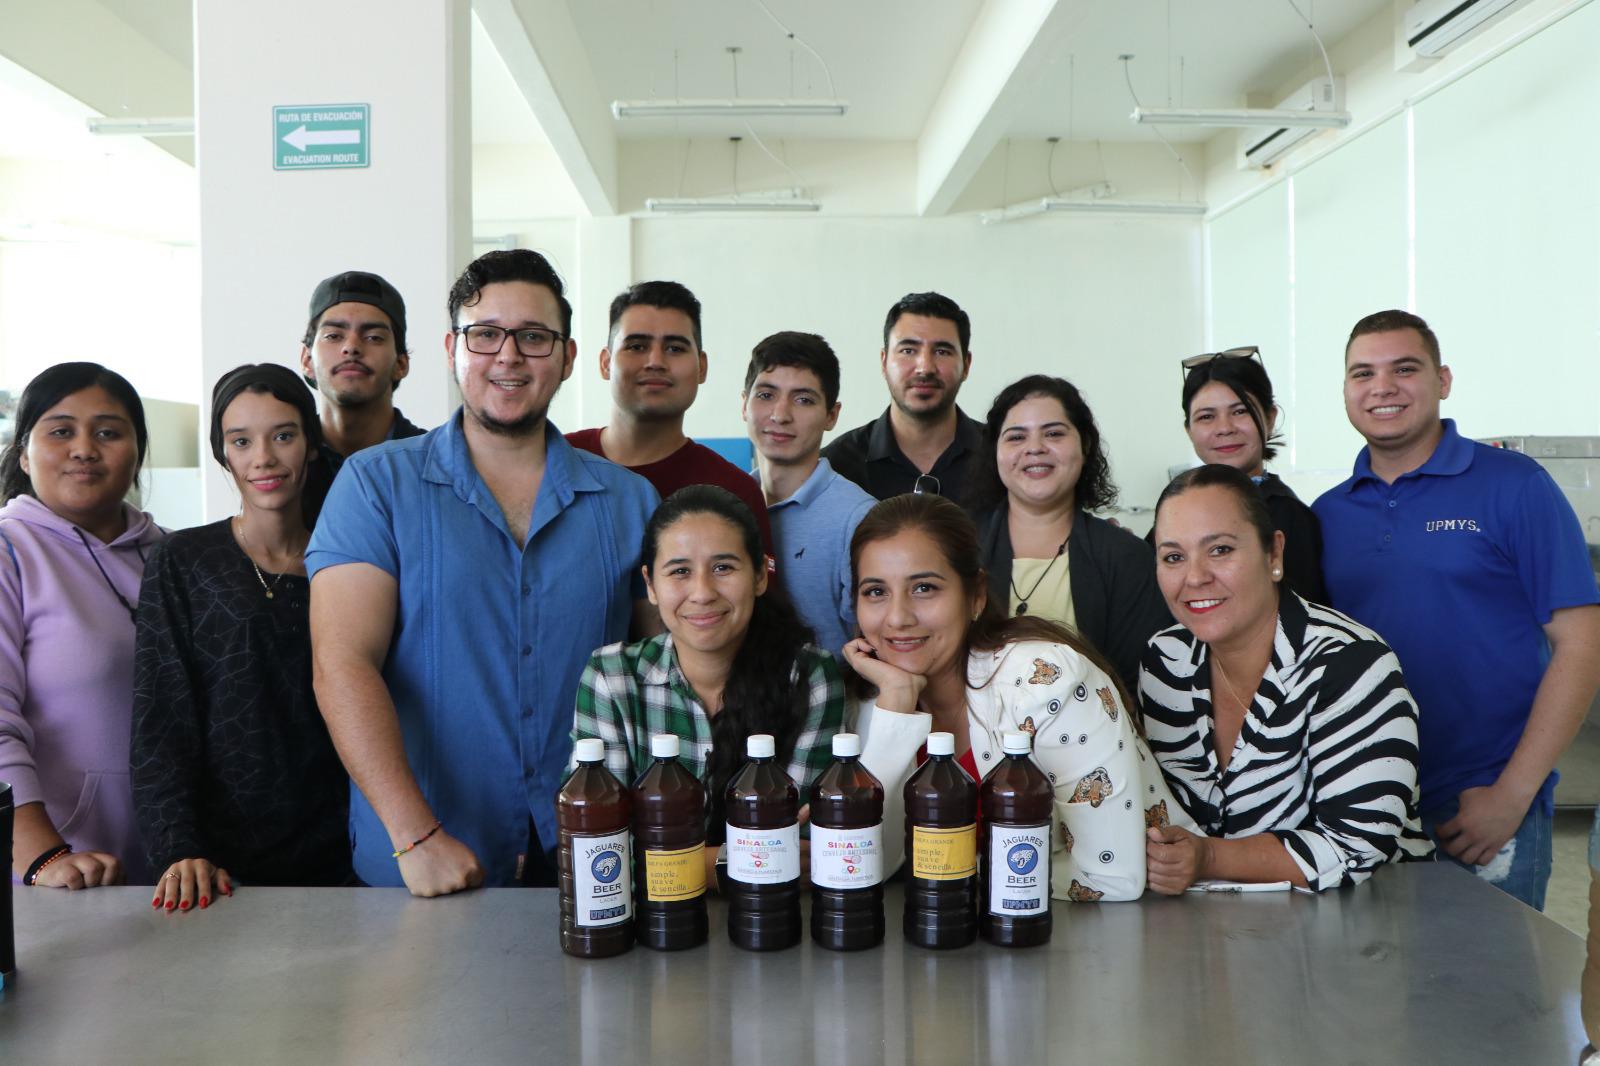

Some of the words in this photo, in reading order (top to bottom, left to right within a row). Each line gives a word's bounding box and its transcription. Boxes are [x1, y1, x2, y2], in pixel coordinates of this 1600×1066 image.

[279, 113, 299, 123] RUTA
[300, 112, 313, 121] DE
[313, 110, 363, 121] EVACUACIÓN
[283, 154, 332, 165] EVACUATION
[332, 153, 360, 163] ROUTE
[736, 838, 783, 847] SINALOA
[827, 840, 873, 849] SINALOA
[1002, 835, 1045, 848] JAGUARES
[585, 842, 626, 859] JAGUARES
[1007, 875, 1037, 884] BEER
[593, 882, 622, 894] BEER
